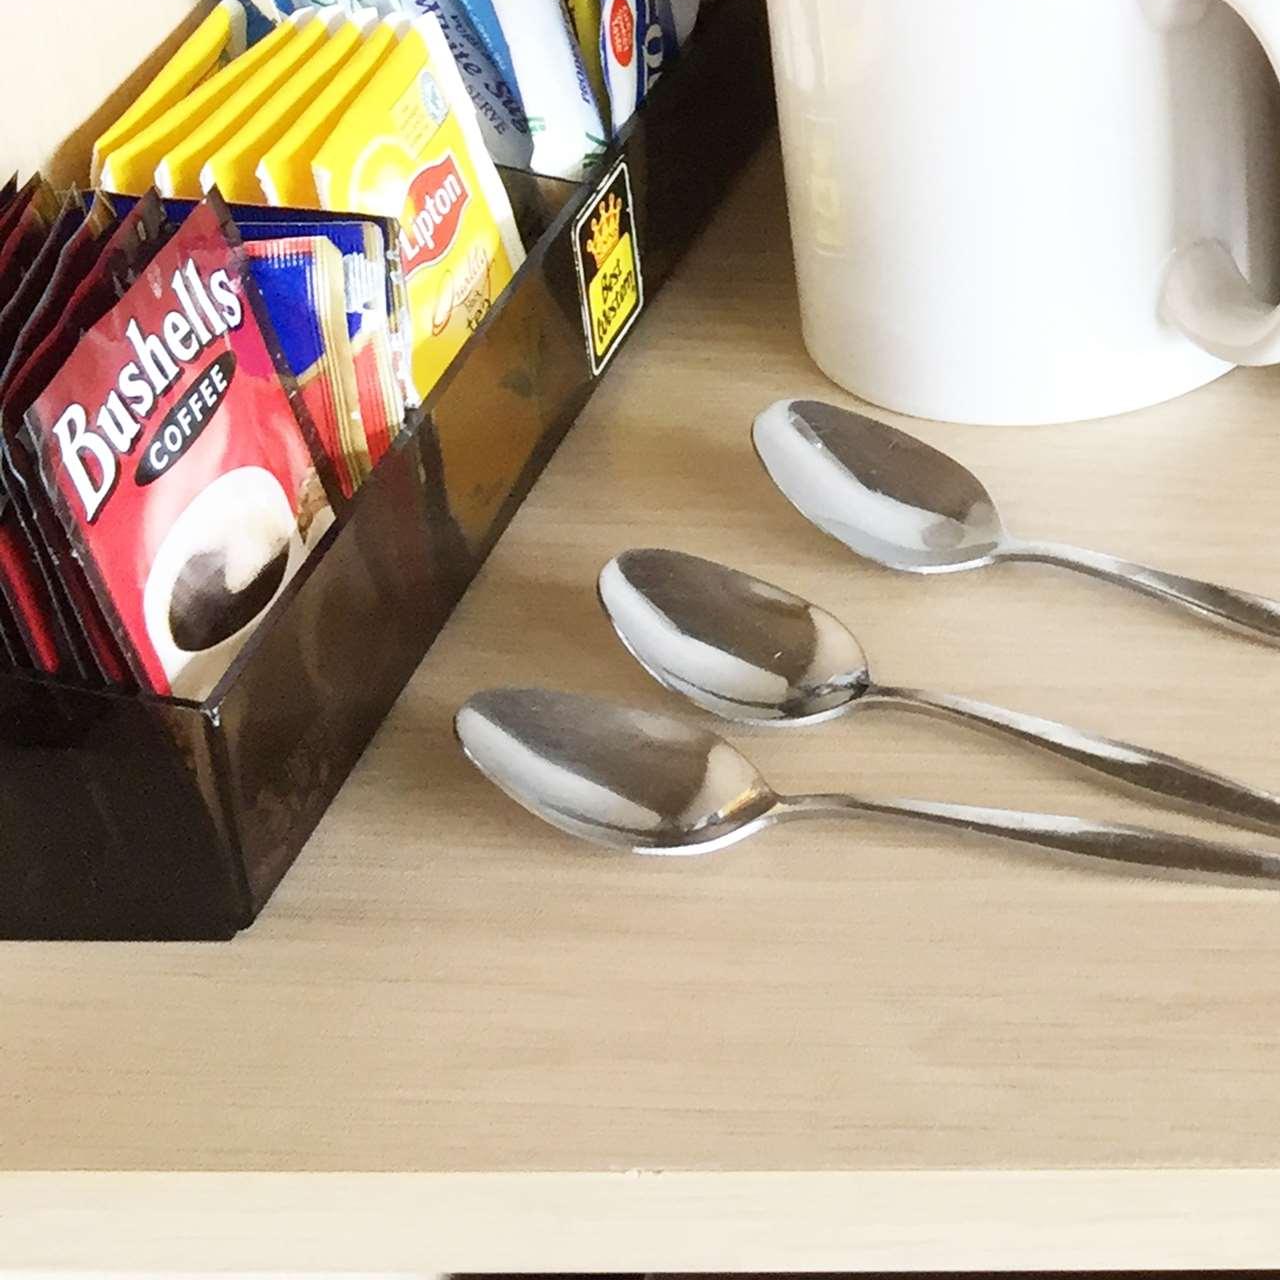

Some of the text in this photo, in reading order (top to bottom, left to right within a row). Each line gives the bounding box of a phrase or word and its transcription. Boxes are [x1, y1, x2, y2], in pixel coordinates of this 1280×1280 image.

[398, 172, 464, 262] Lipton
[602, 258, 623, 306] Best
[52, 257, 243, 523] Bushells
[150, 363, 228, 471] COFFEE
